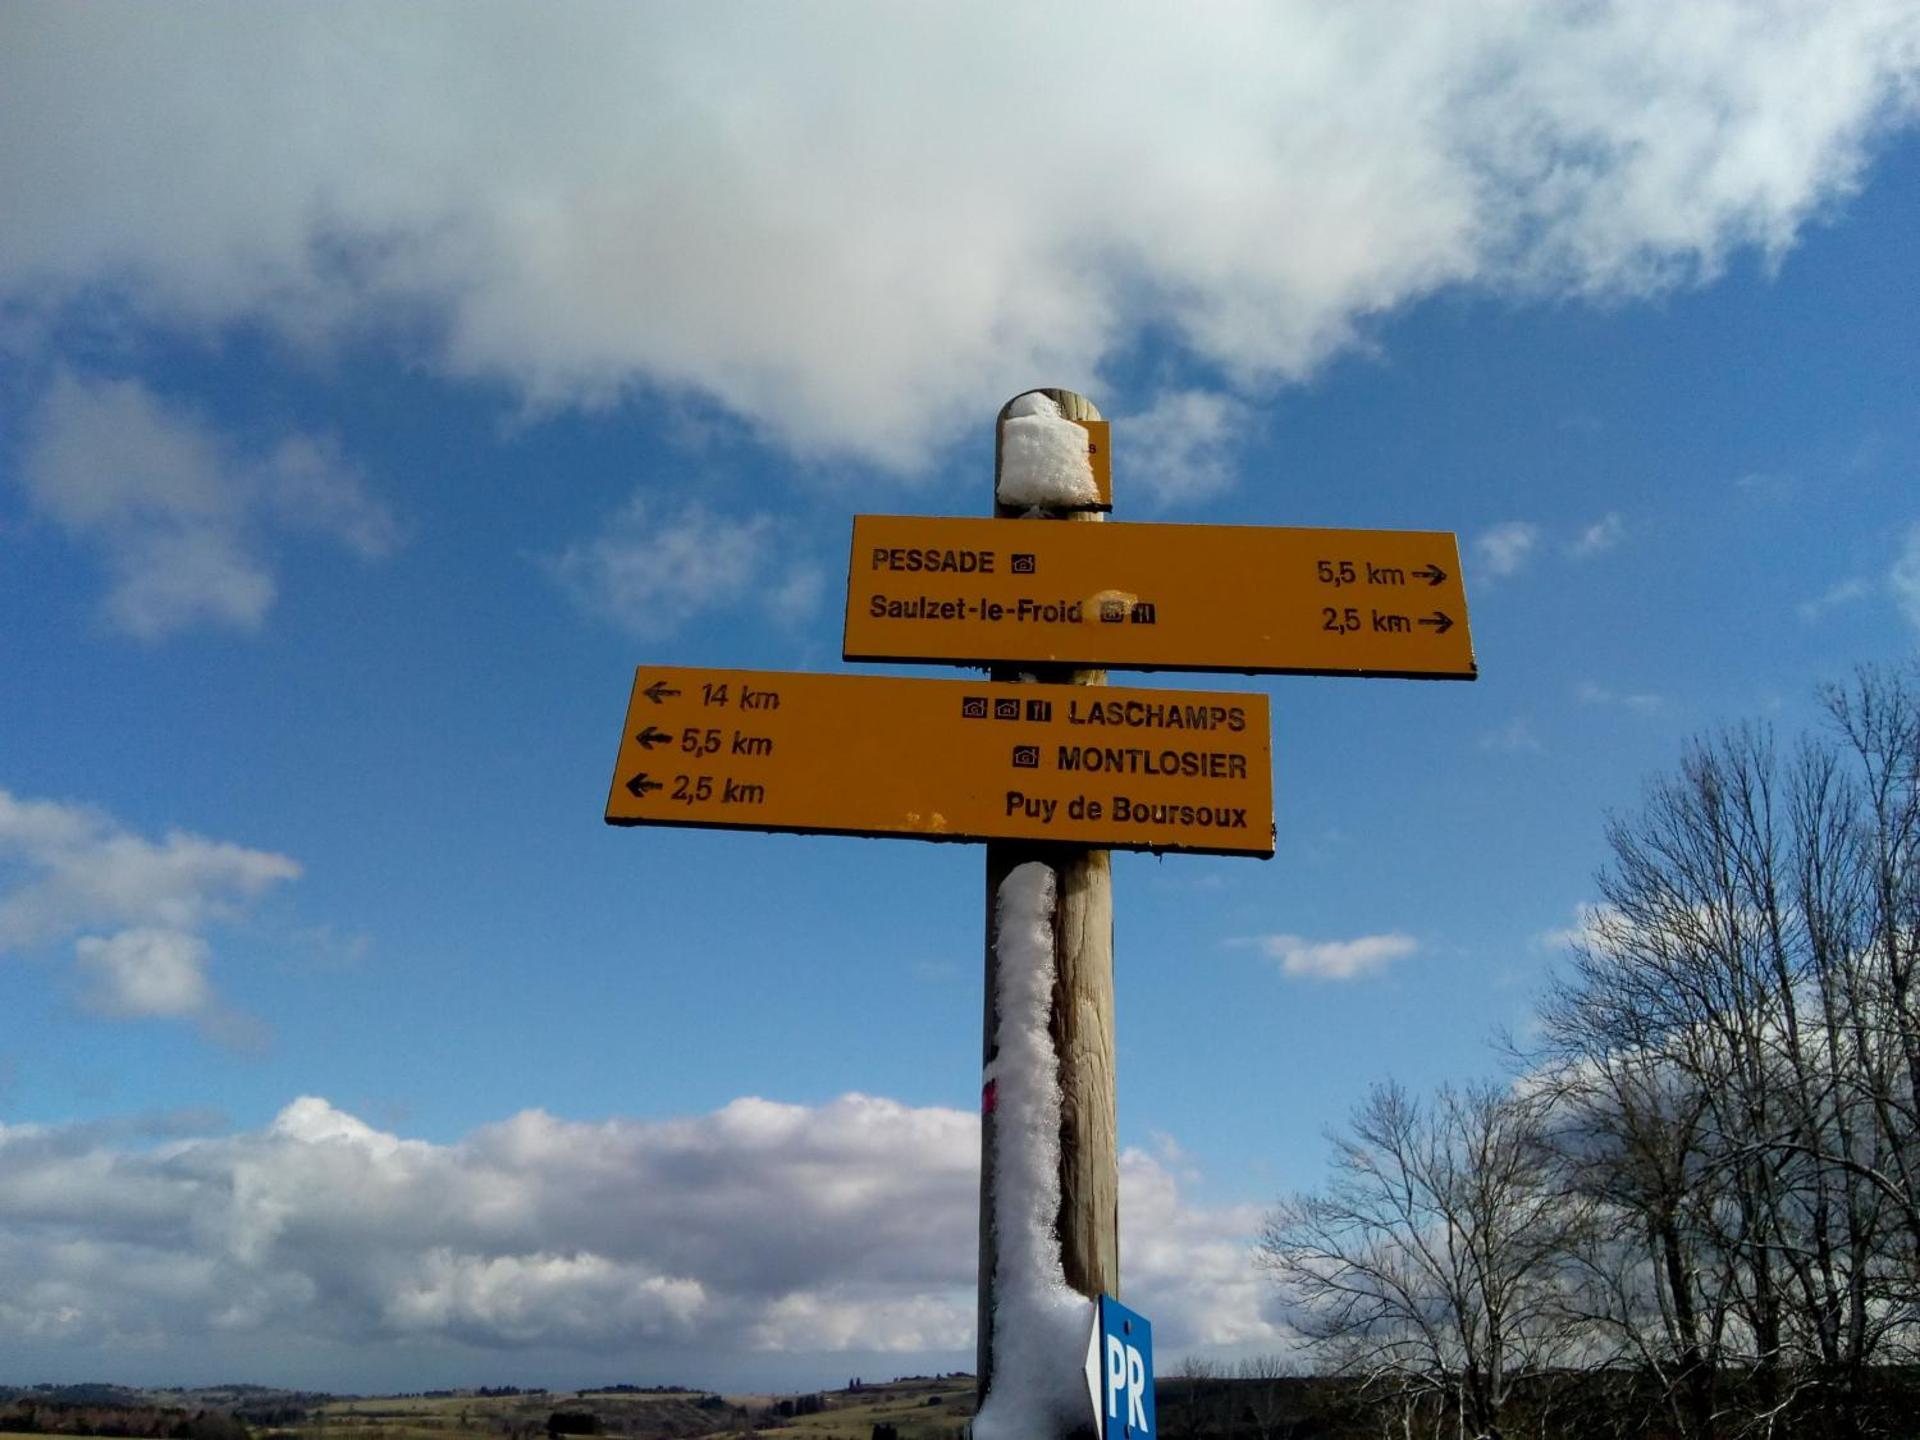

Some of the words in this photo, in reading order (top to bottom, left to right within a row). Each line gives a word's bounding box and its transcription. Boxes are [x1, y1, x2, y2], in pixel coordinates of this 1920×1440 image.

[872, 548, 995, 574] PESSADE
[1317, 560, 1356, 588] 5,5
[1366, 562, 1405, 585] km
[869, 595, 1084, 624] Saulzet-le-Froid
[1322, 607, 1361, 636] 2,5
[1372, 608, 1412, 633] km
[702, 683, 729, 707] 14
[739, 685, 780, 711] km
[1068, 700, 1246, 732] LASCHAMPS
[681, 727, 722, 758] 5,5
[731, 730, 773, 756] km
[1057, 746, 1248, 779] MONTLOSIER
[670, 774, 713, 806] 2,5
[721, 777, 765, 804] km
[1005, 791, 1057, 824] Puy
[1068, 795, 1102, 820] de
[1111, 797, 1248, 828] Boursoux
[1106, 1333, 1149, 1433] PR
